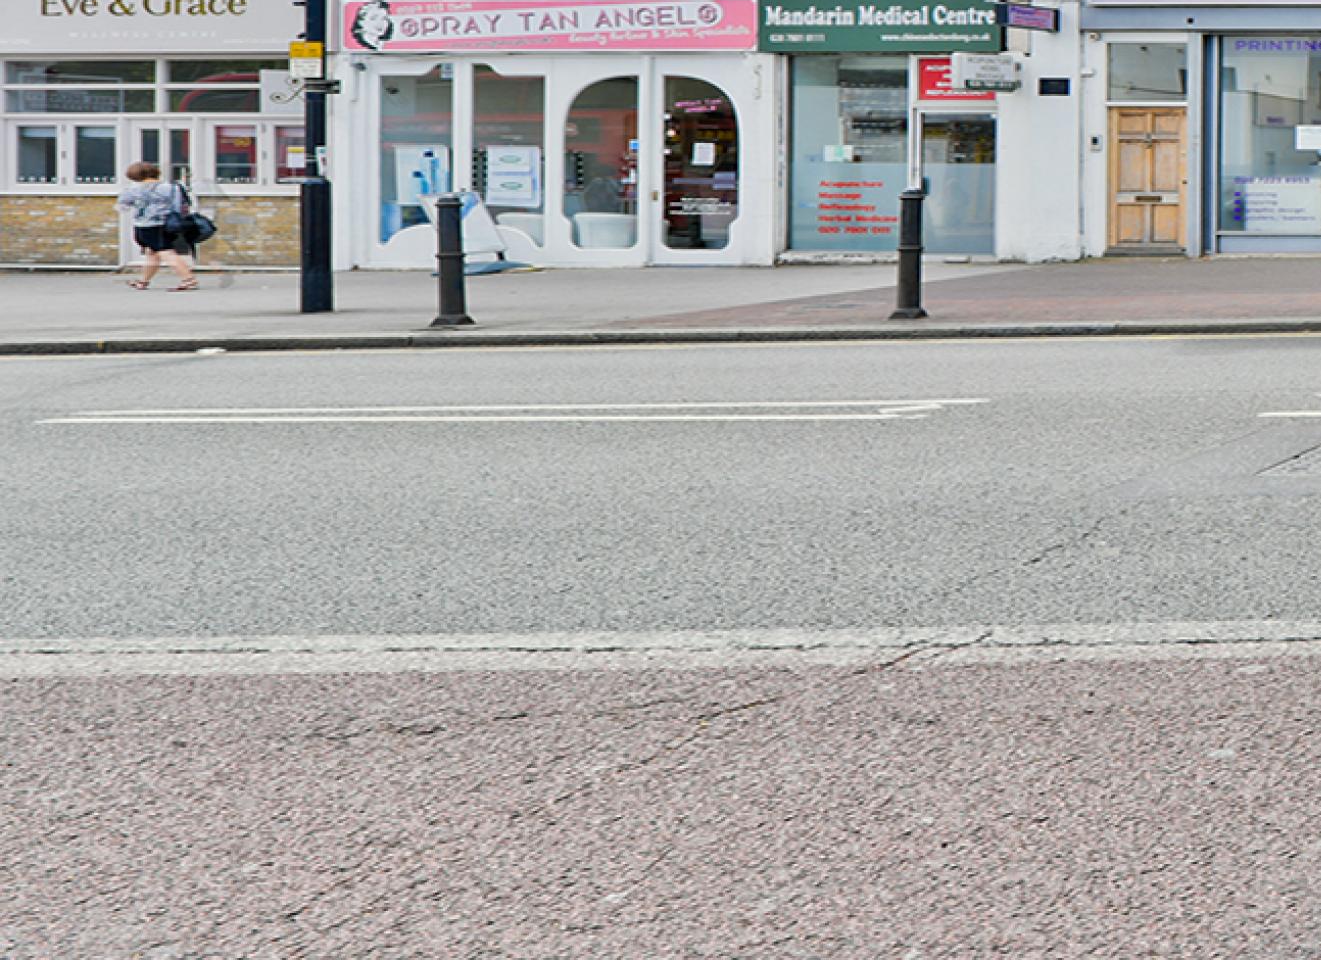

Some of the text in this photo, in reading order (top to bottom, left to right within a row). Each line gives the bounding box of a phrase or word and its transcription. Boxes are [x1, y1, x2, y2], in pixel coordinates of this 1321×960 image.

[517, 10, 580, 33] TAN
[765, 4, 854, 26] Mandarin
[858, 4, 929, 26] Medical
[933, 4, 996, 26] Centre
